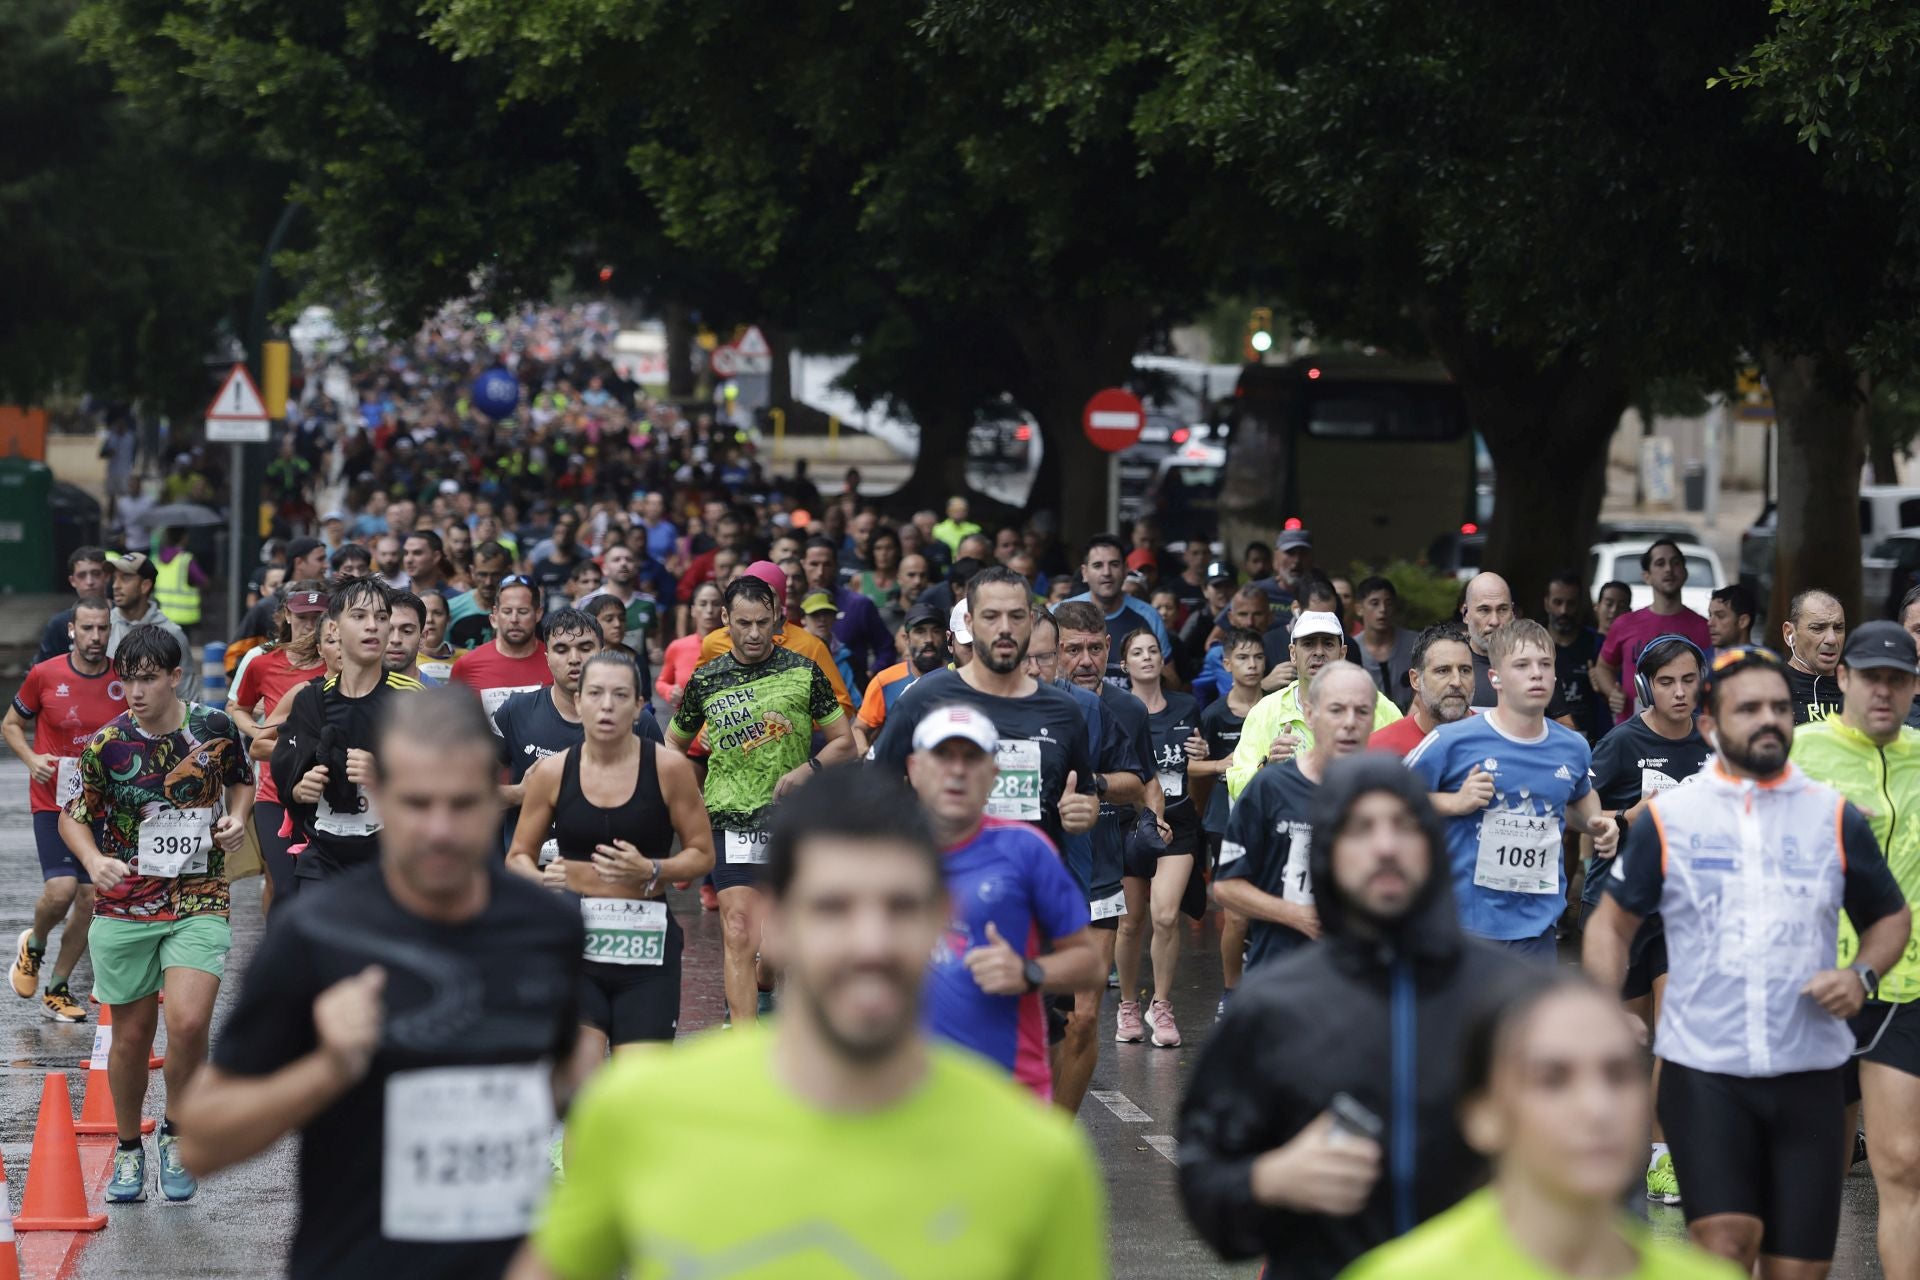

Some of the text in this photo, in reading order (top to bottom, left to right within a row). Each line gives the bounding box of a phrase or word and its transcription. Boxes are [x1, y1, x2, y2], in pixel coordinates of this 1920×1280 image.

[704, 687, 755, 719] CORRER
[714, 706, 752, 732] PARA
[719, 721, 766, 750] COMER
[153, 836, 202, 854] 3987
[1496, 845, 1547, 868] 1081
[583, 932, 659, 958] 22285
